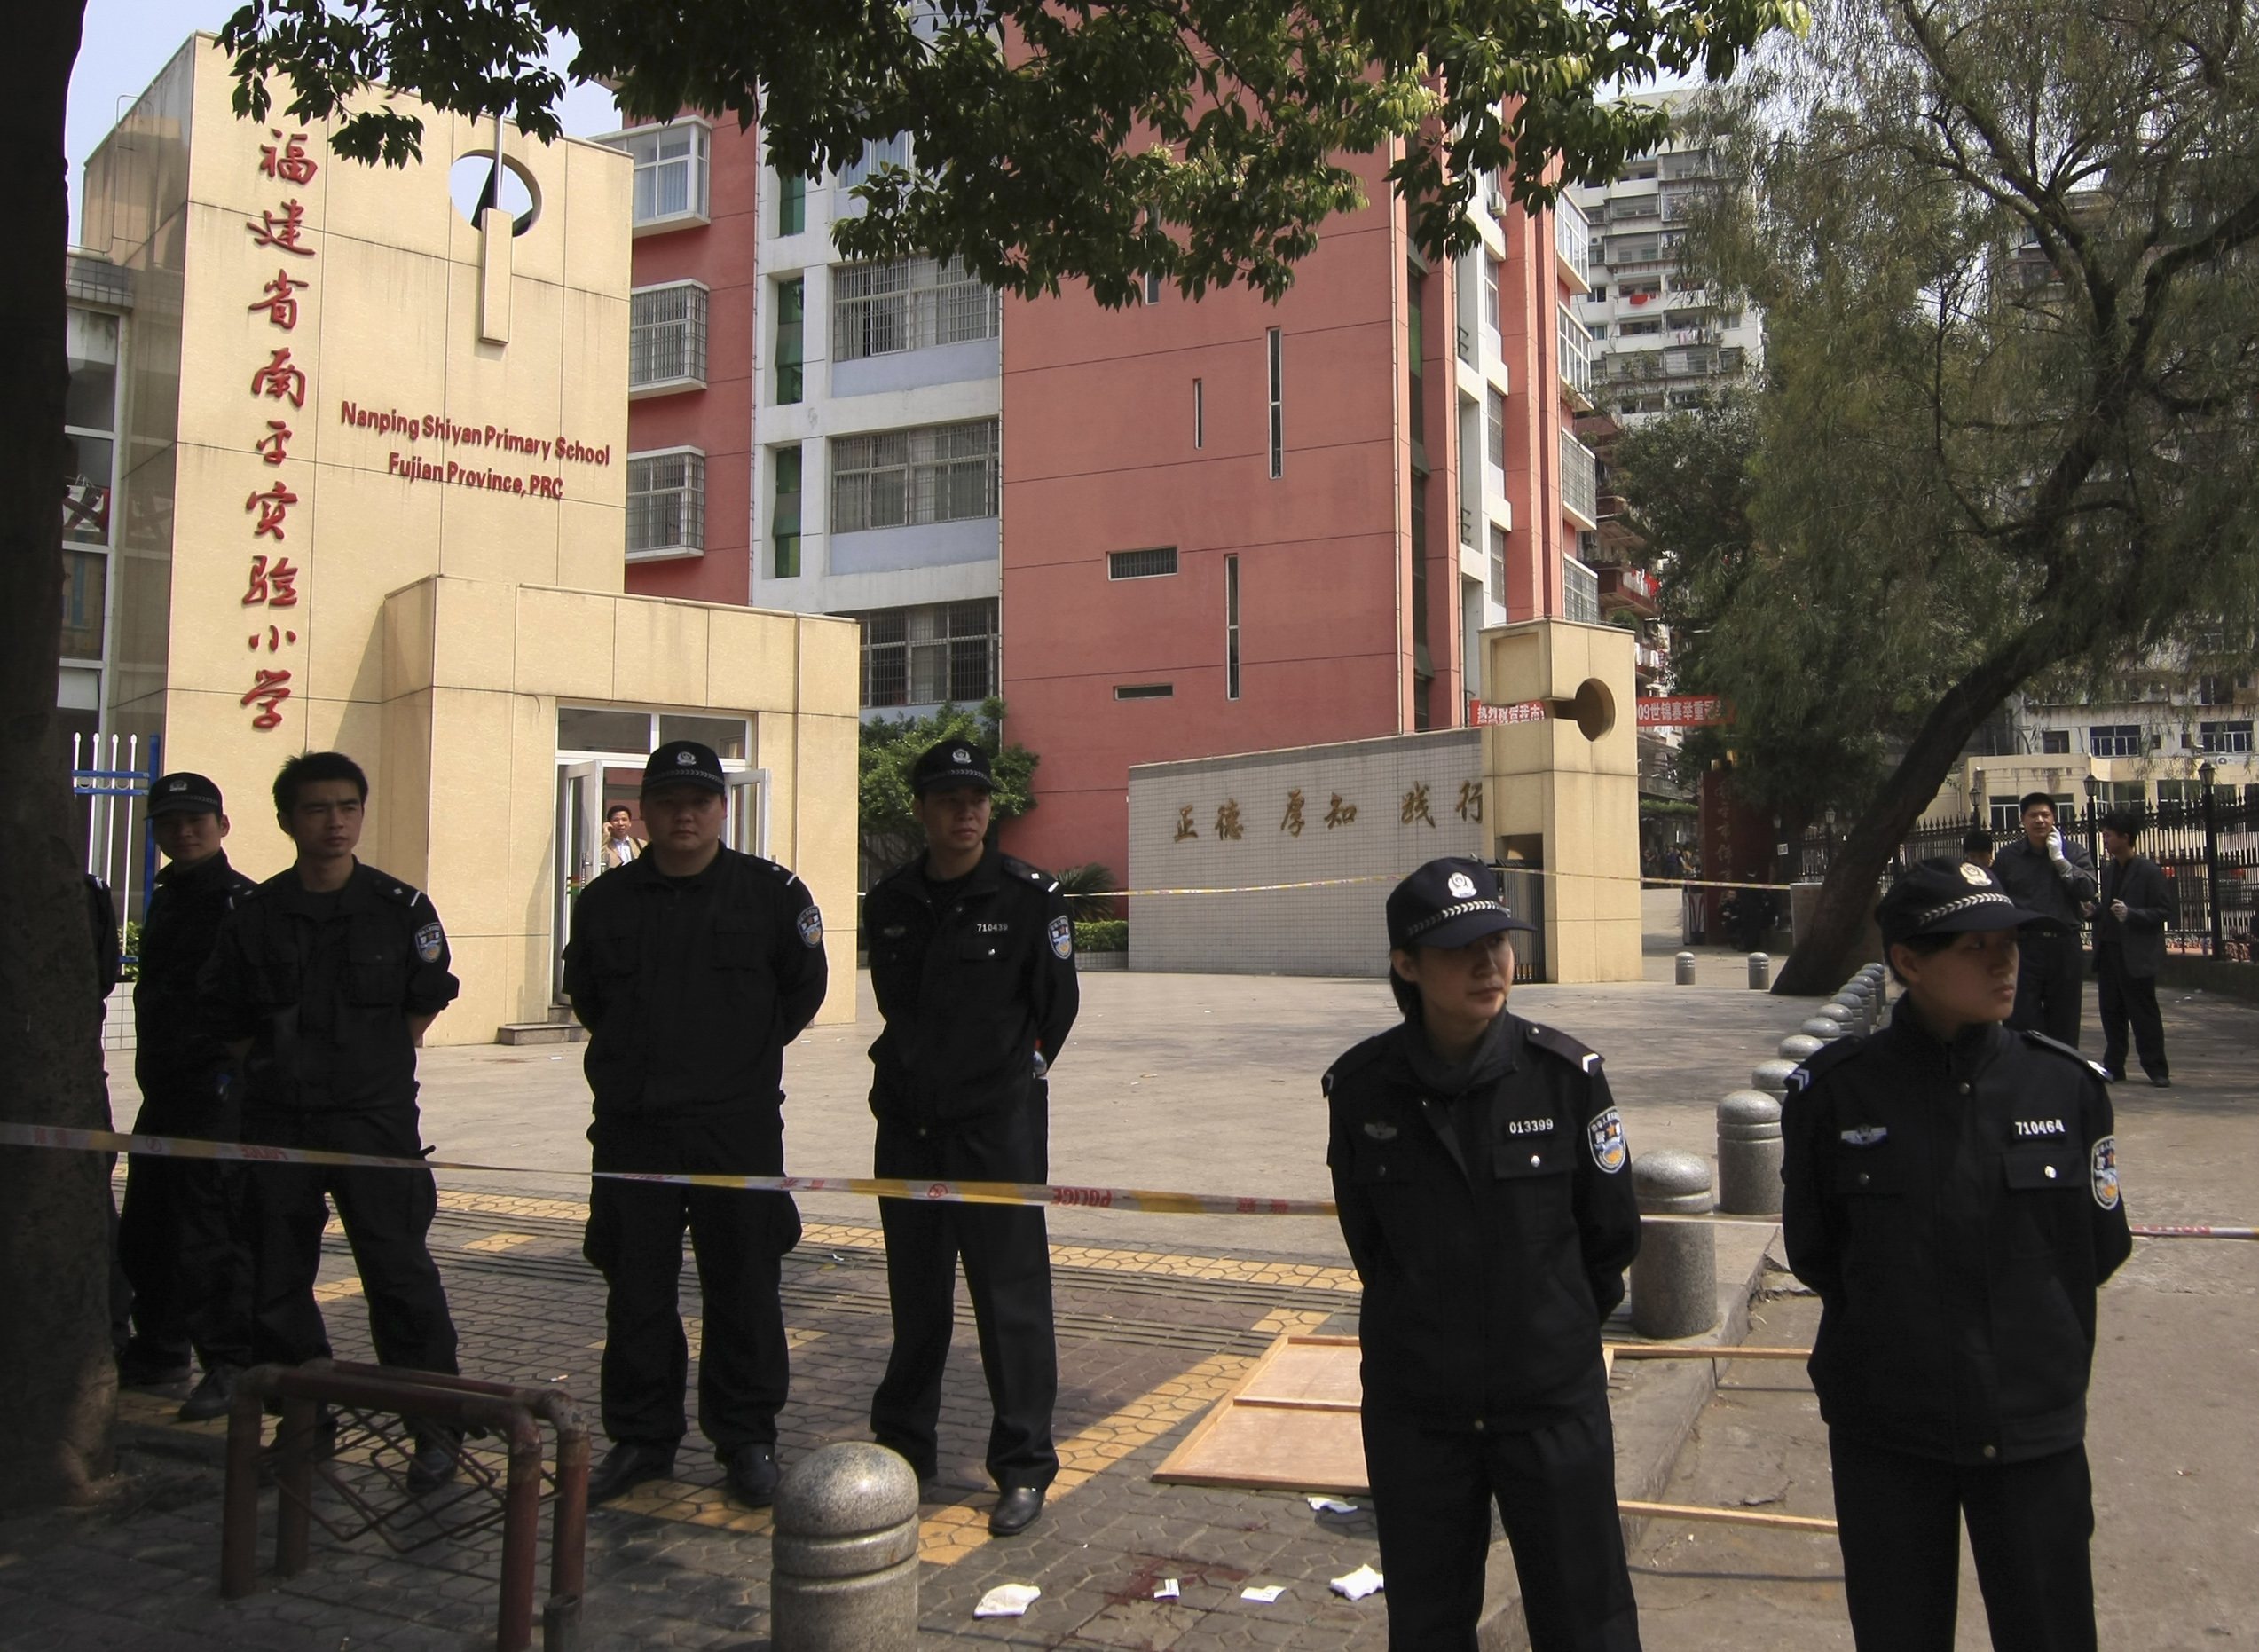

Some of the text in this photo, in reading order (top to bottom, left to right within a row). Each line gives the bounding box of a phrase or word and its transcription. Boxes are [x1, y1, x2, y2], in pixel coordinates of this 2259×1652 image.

[240, 128, 318, 729] 福建省南平实验小学
[341, 401, 610, 467] Nanping Shiyan Primary School
[389, 452, 563, 499] Fujian Province, PRC
[1509, 1118, 1554, 1134] 013399
[2014, 1118, 2066, 1135] 710464
[1051, 1187, 1113, 1207] POLICE
